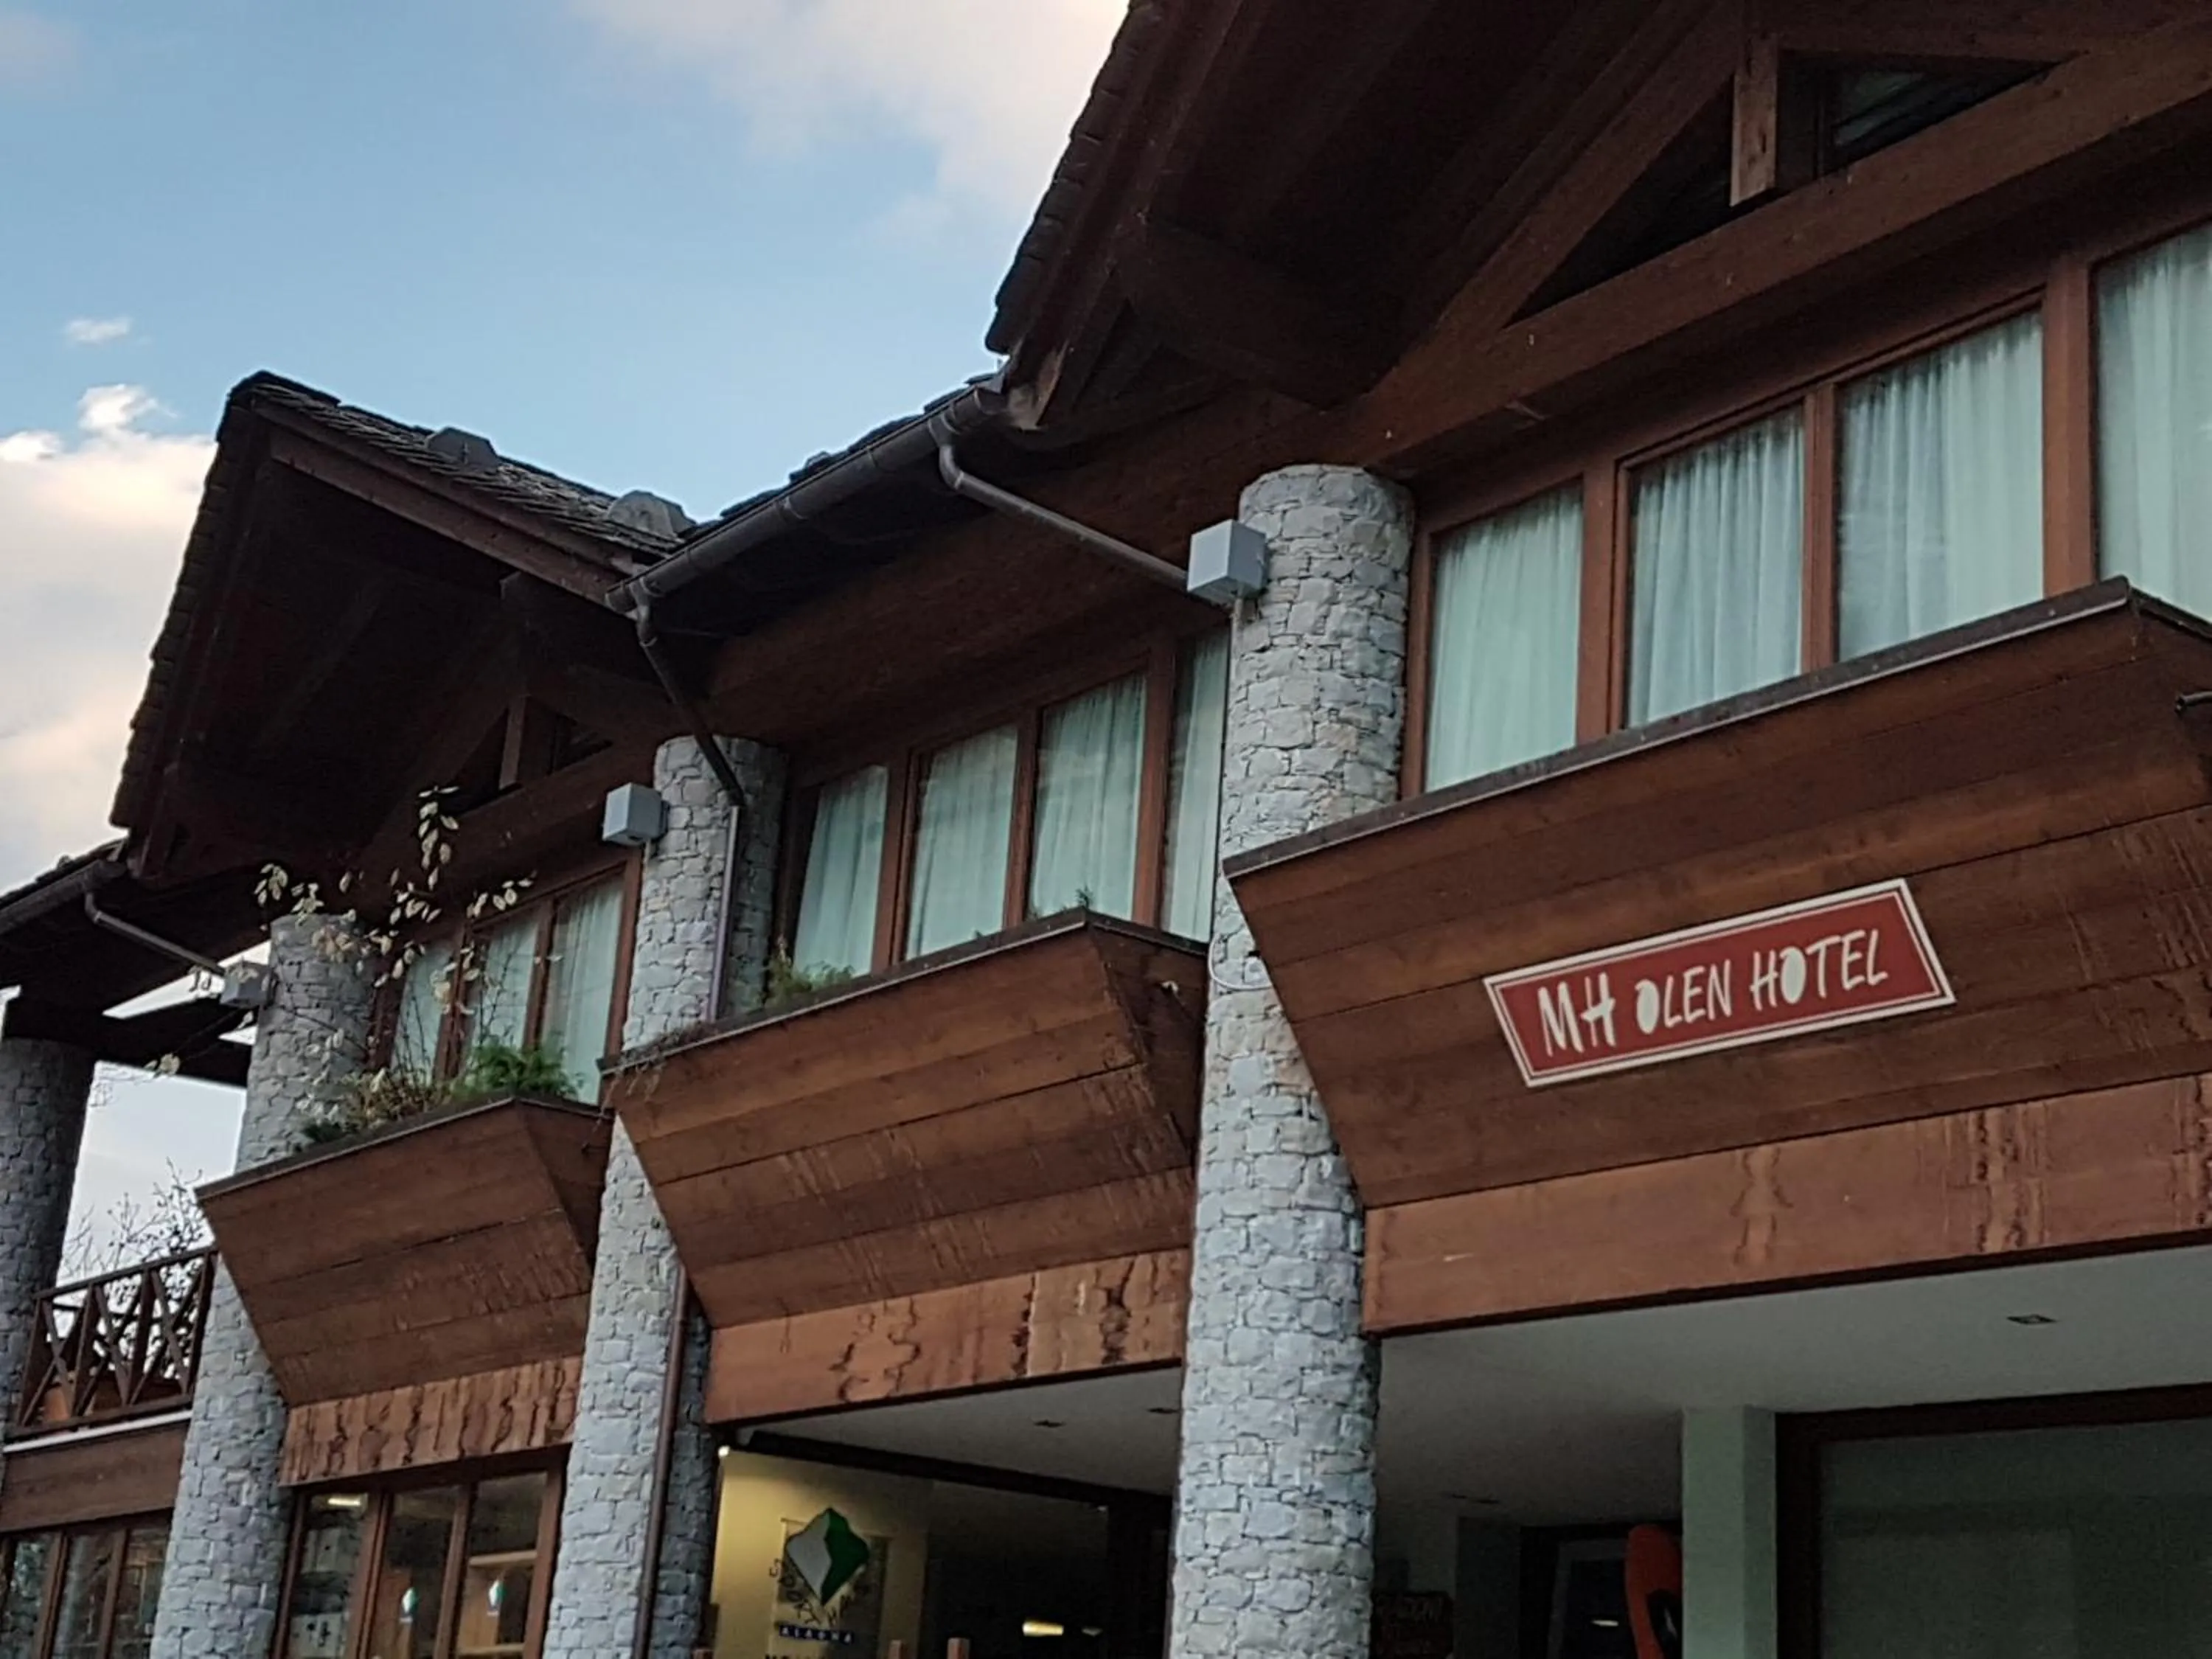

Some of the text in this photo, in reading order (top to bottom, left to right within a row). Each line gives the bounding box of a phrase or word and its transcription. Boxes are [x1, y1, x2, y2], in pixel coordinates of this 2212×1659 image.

[1537, 928, 1888, 1057] MH OLEN HOTEL
